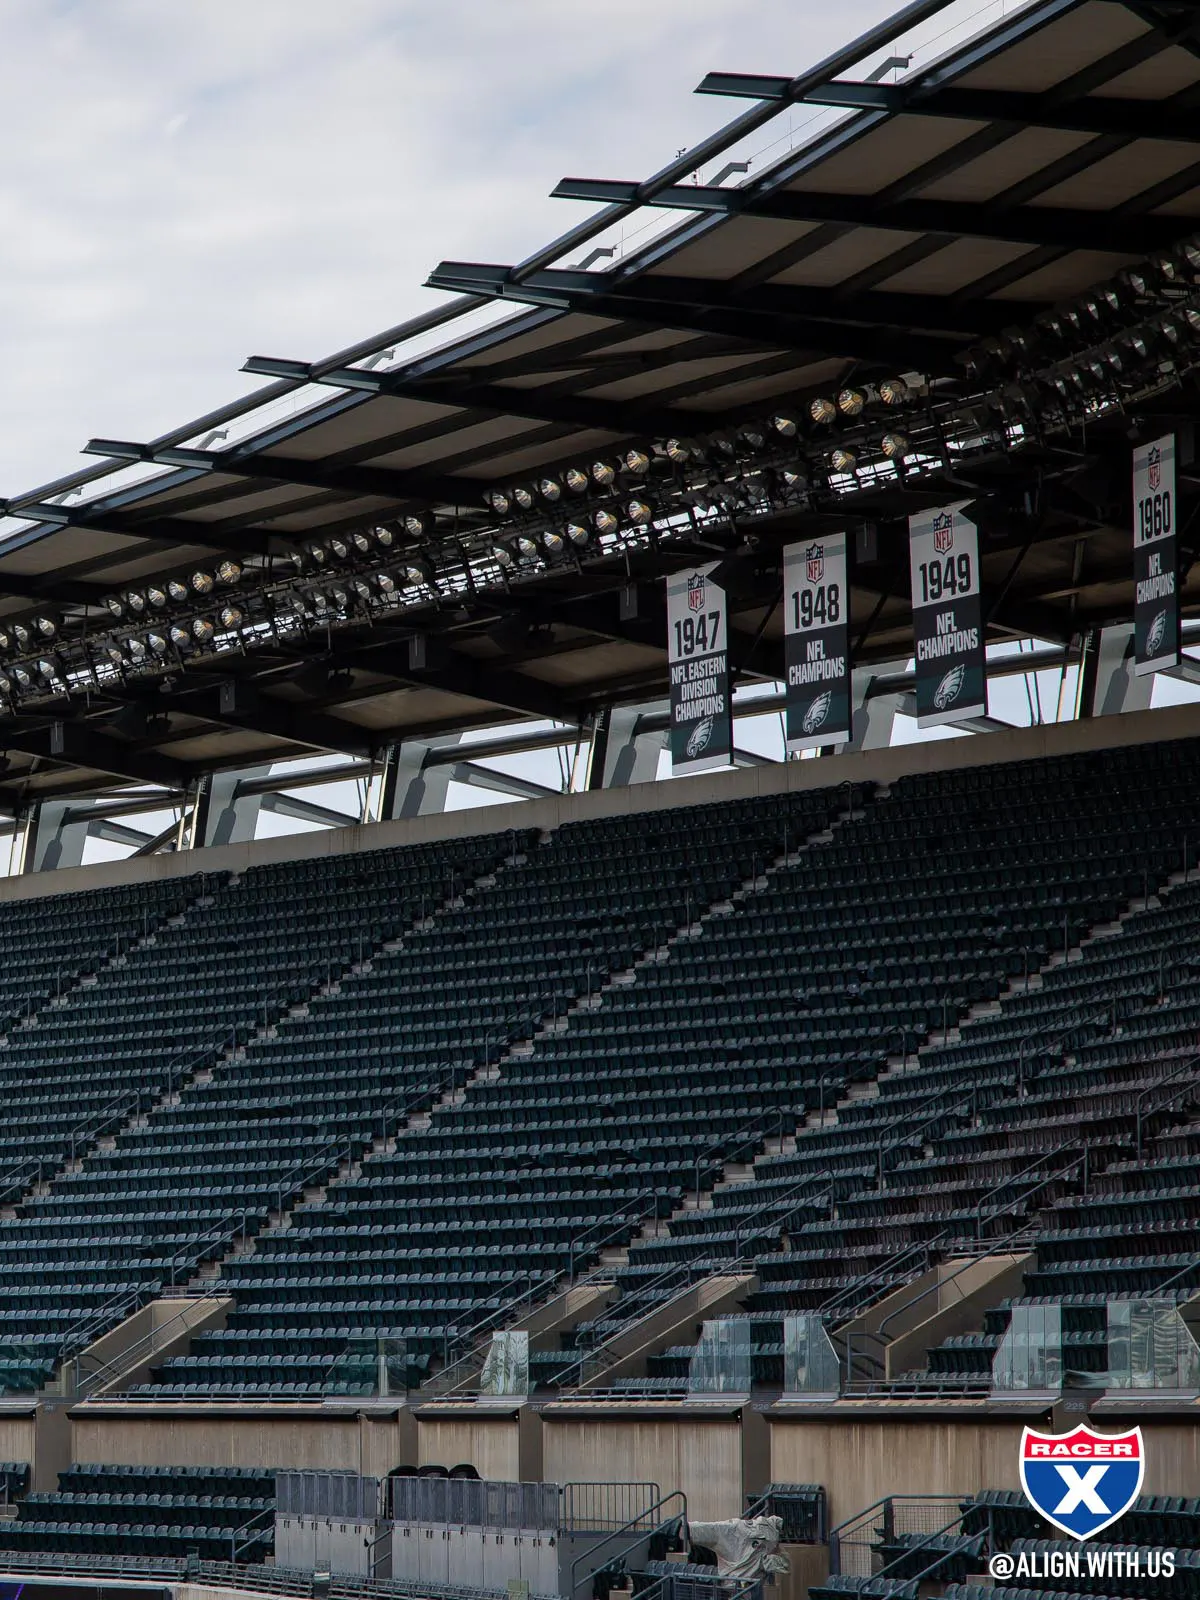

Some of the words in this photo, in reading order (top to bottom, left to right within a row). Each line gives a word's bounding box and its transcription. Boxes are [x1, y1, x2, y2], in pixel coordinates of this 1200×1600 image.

[1139, 491, 1170, 541] 1960
[935, 529, 950, 550] NFL
[808, 559, 822, 580] NFL
[919, 553, 972, 602] 1949
[1149, 552, 1161, 576] NFL
[688, 587, 705, 608] NFL
[1136, 571, 1175, 605] CHAMPIONS
[791, 583, 840, 629] 1948
[674, 610, 721, 658] 1947
[936, 611, 957, 635] NFL
[806, 639, 826, 662] NFL
[917, 627, 979, 661] CHAMPIONS
[671, 667, 688, 685] NFL
[688, 655, 726, 680] EASTERN
[788, 656, 845, 686] CHAMPIONS
[681, 676, 717, 701] DIVISION
[675, 694, 725, 723] CHAMPIONS
[1064, 1402, 1086, 1411] 225
